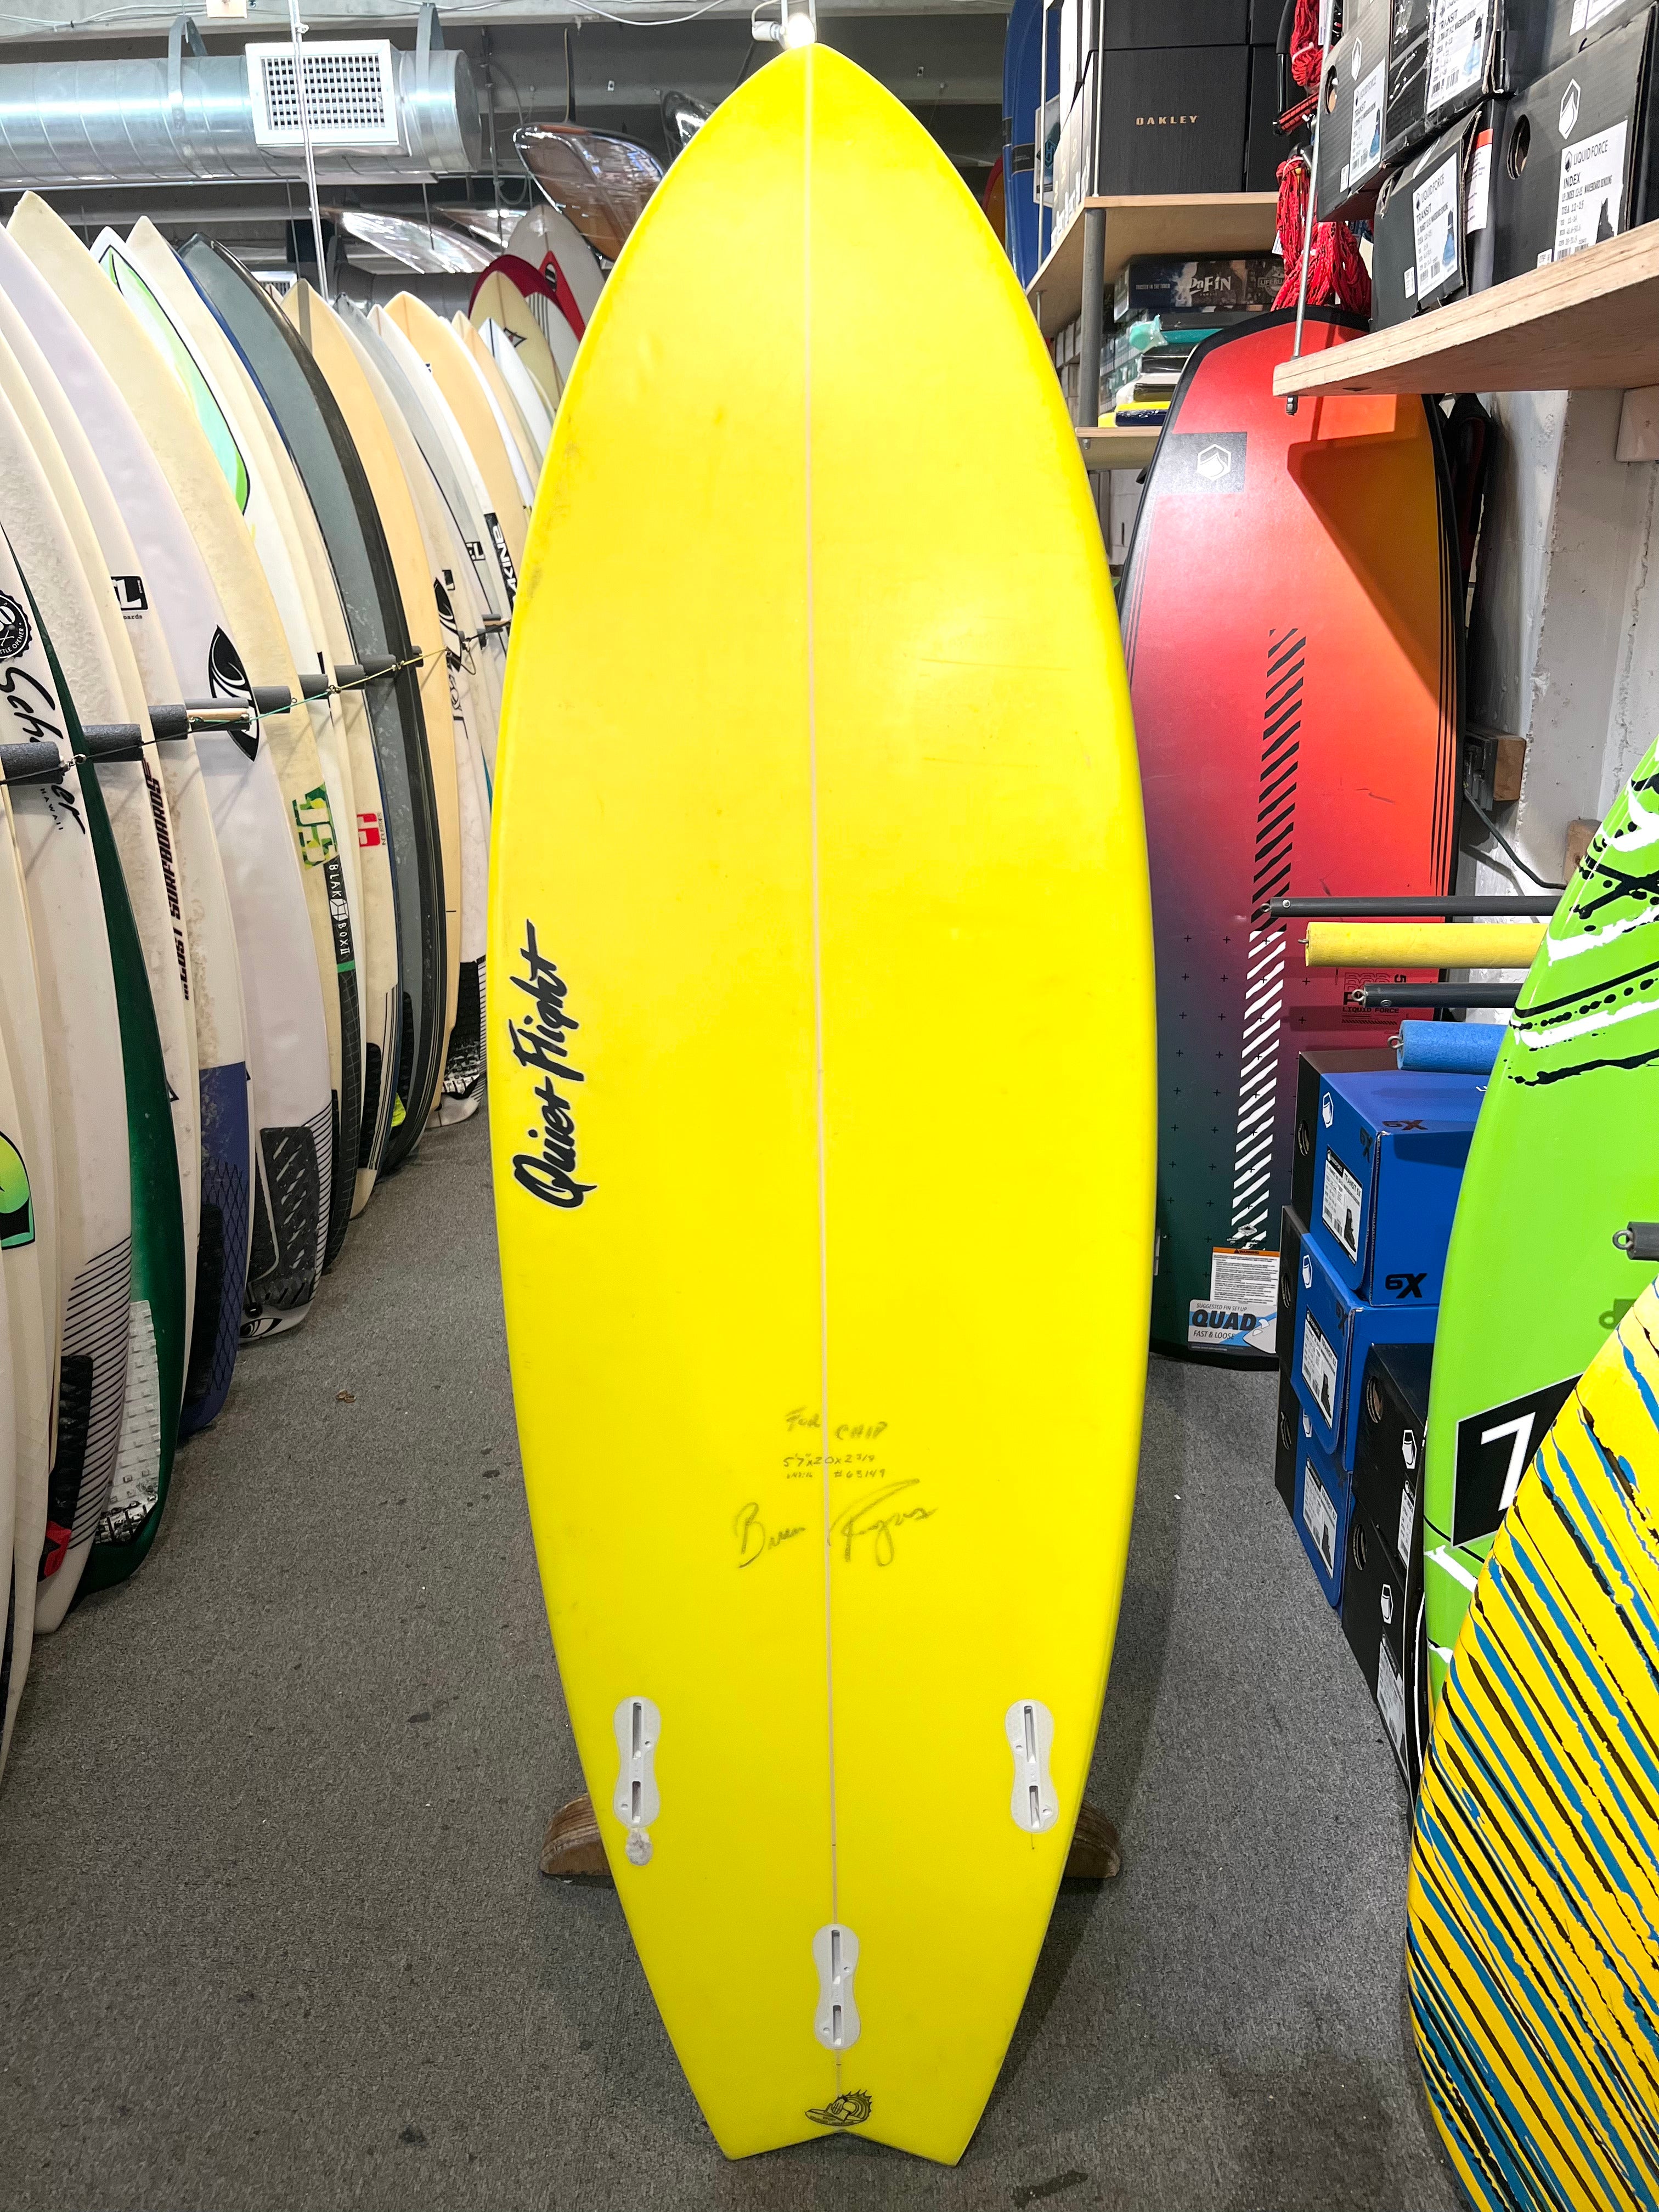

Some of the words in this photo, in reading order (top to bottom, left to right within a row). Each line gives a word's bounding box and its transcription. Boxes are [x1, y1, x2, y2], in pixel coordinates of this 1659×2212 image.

[1136, 115, 1197, 125] OAKLEY
[1564, 172, 1581, 189] INDEX
[493, 522, 516, 603] AKINE
[12, 628, 24, 649] OPENER
[0, 667, 86, 834] Scher
[40, 788, 64, 830] HAWAII
[146, 776, 180, 920] SURFBOARDS
[328, 863, 342, 898] BLAK
[509, 918, 584, 1082] Flight
[512, 1075, 598, 1209] Quiet
[1385, 1273, 1427, 1299] 6X
[1192, 1309, 1257, 1331] QUAD
[836, 1421, 888, 1440] CHIP
